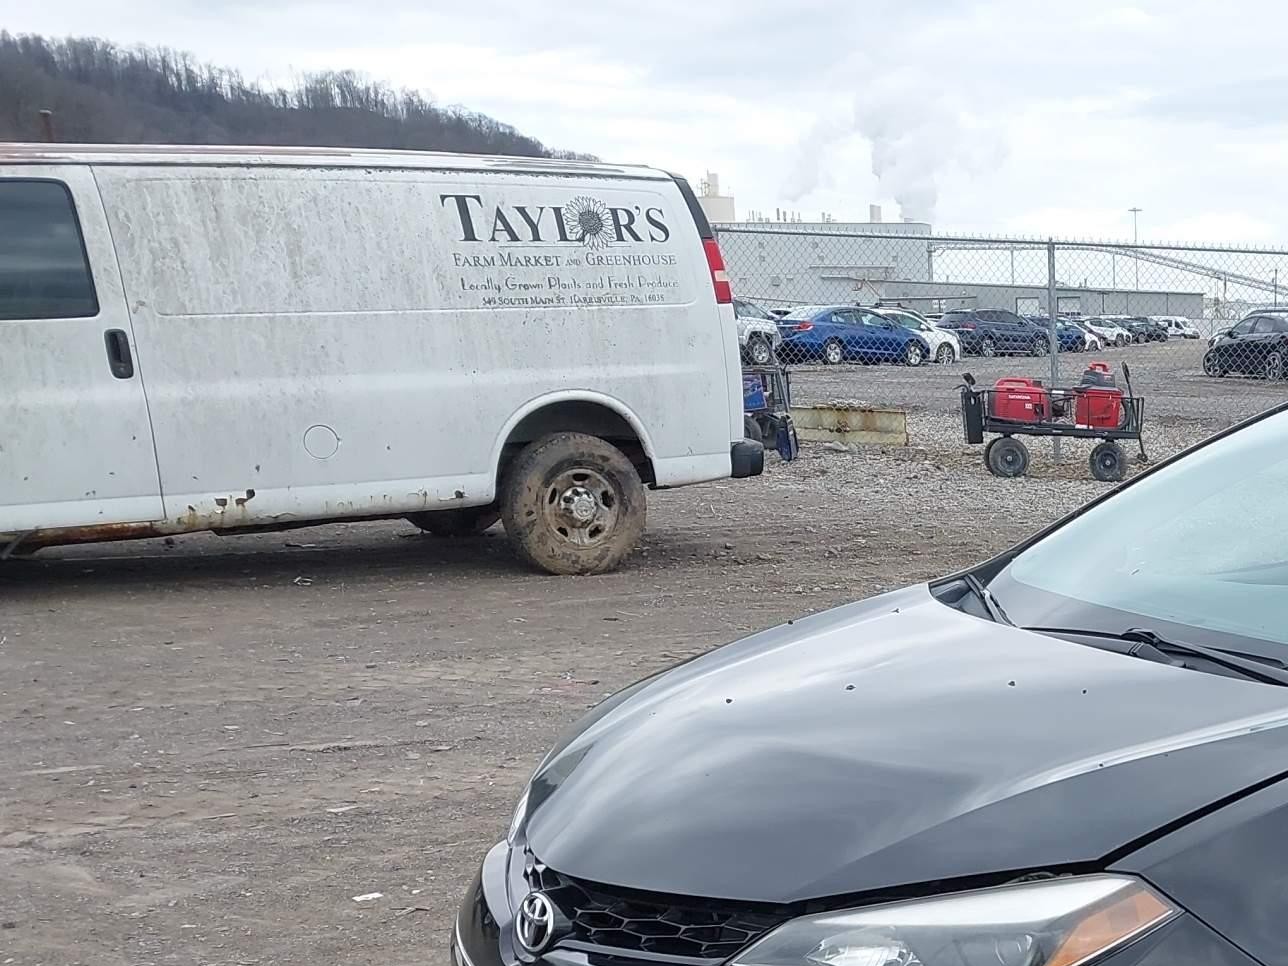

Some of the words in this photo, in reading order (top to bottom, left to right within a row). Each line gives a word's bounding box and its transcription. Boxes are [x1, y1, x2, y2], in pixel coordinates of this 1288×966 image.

[453, 253, 495, 267] FARM
[499, 252, 561, 267] MARKET
[585, 252, 677, 266] GREENHOUSE
[461, 276, 501, 293] Locally
[505, 276, 543, 290] Grown
[547, 276, 581, 290] Plants
[586, 275, 603, 289] and
[607, 275, 634, 288] Fresh
[638, 275, 679, 288] Produce
[530, 296, 555, 305] MAIN
